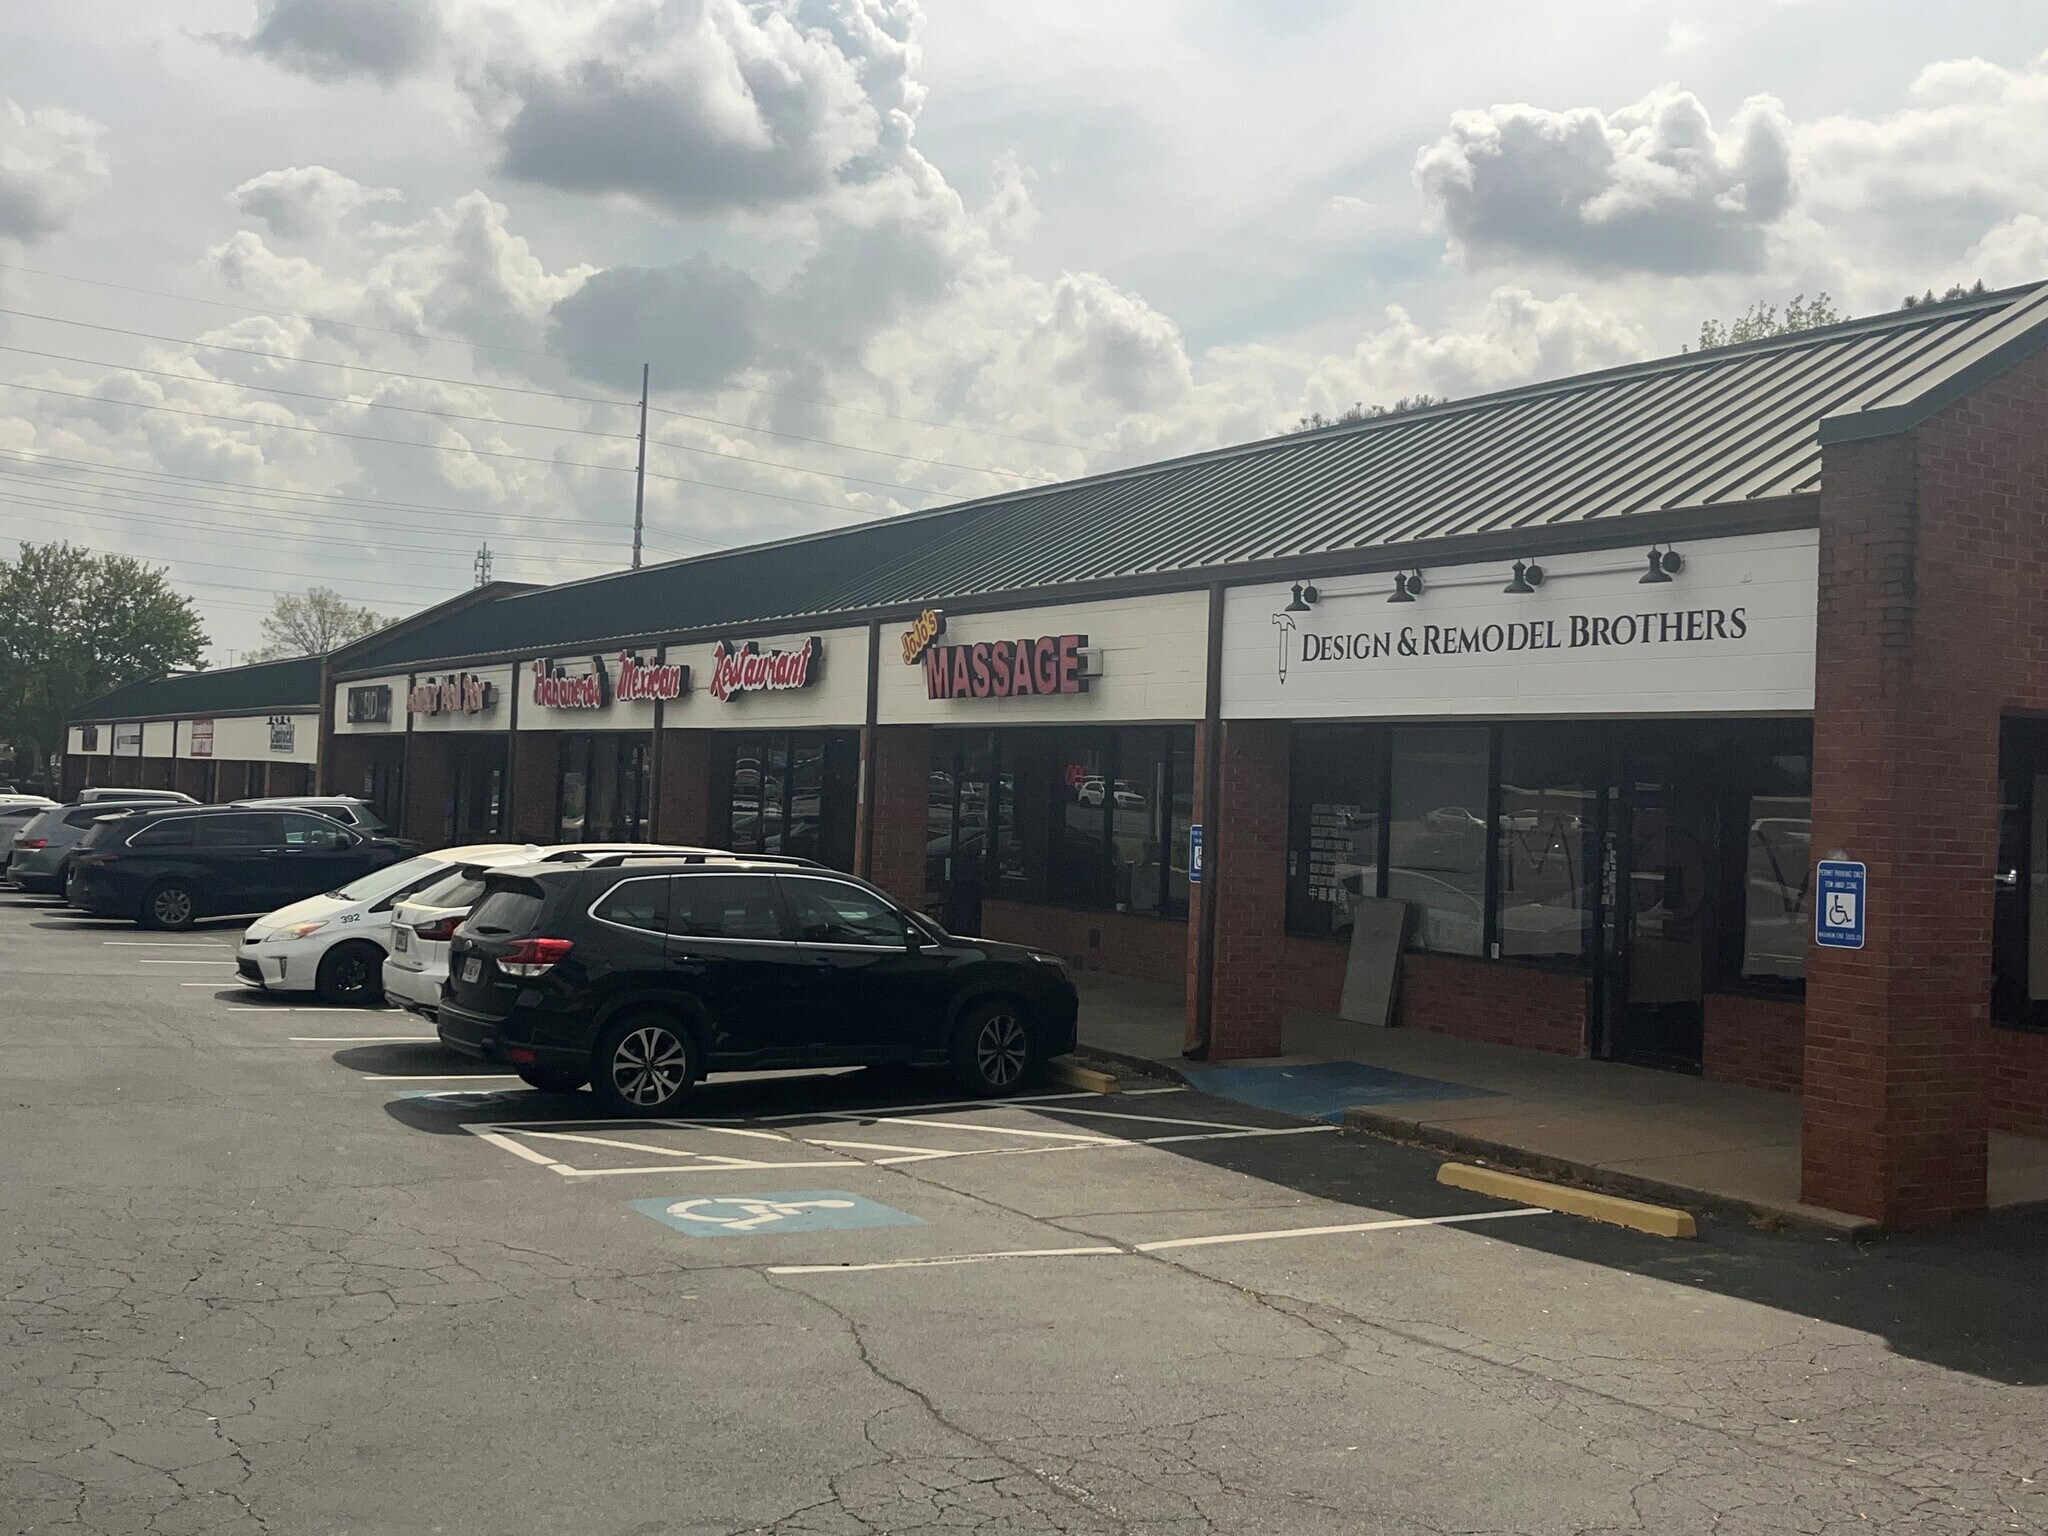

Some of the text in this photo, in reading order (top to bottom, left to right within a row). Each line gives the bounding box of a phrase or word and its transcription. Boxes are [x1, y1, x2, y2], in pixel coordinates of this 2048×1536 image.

[1301, 631, 1391, 662] DESIGN
[1569, 607, 1747, 648] BROTHERS
[615, 648, 681, 702] Mexican
[710, 636, 814, 703] Restaurant
[926, 634, 1081, 700] MASSAGE
[340, 912, 361, 925] 392
